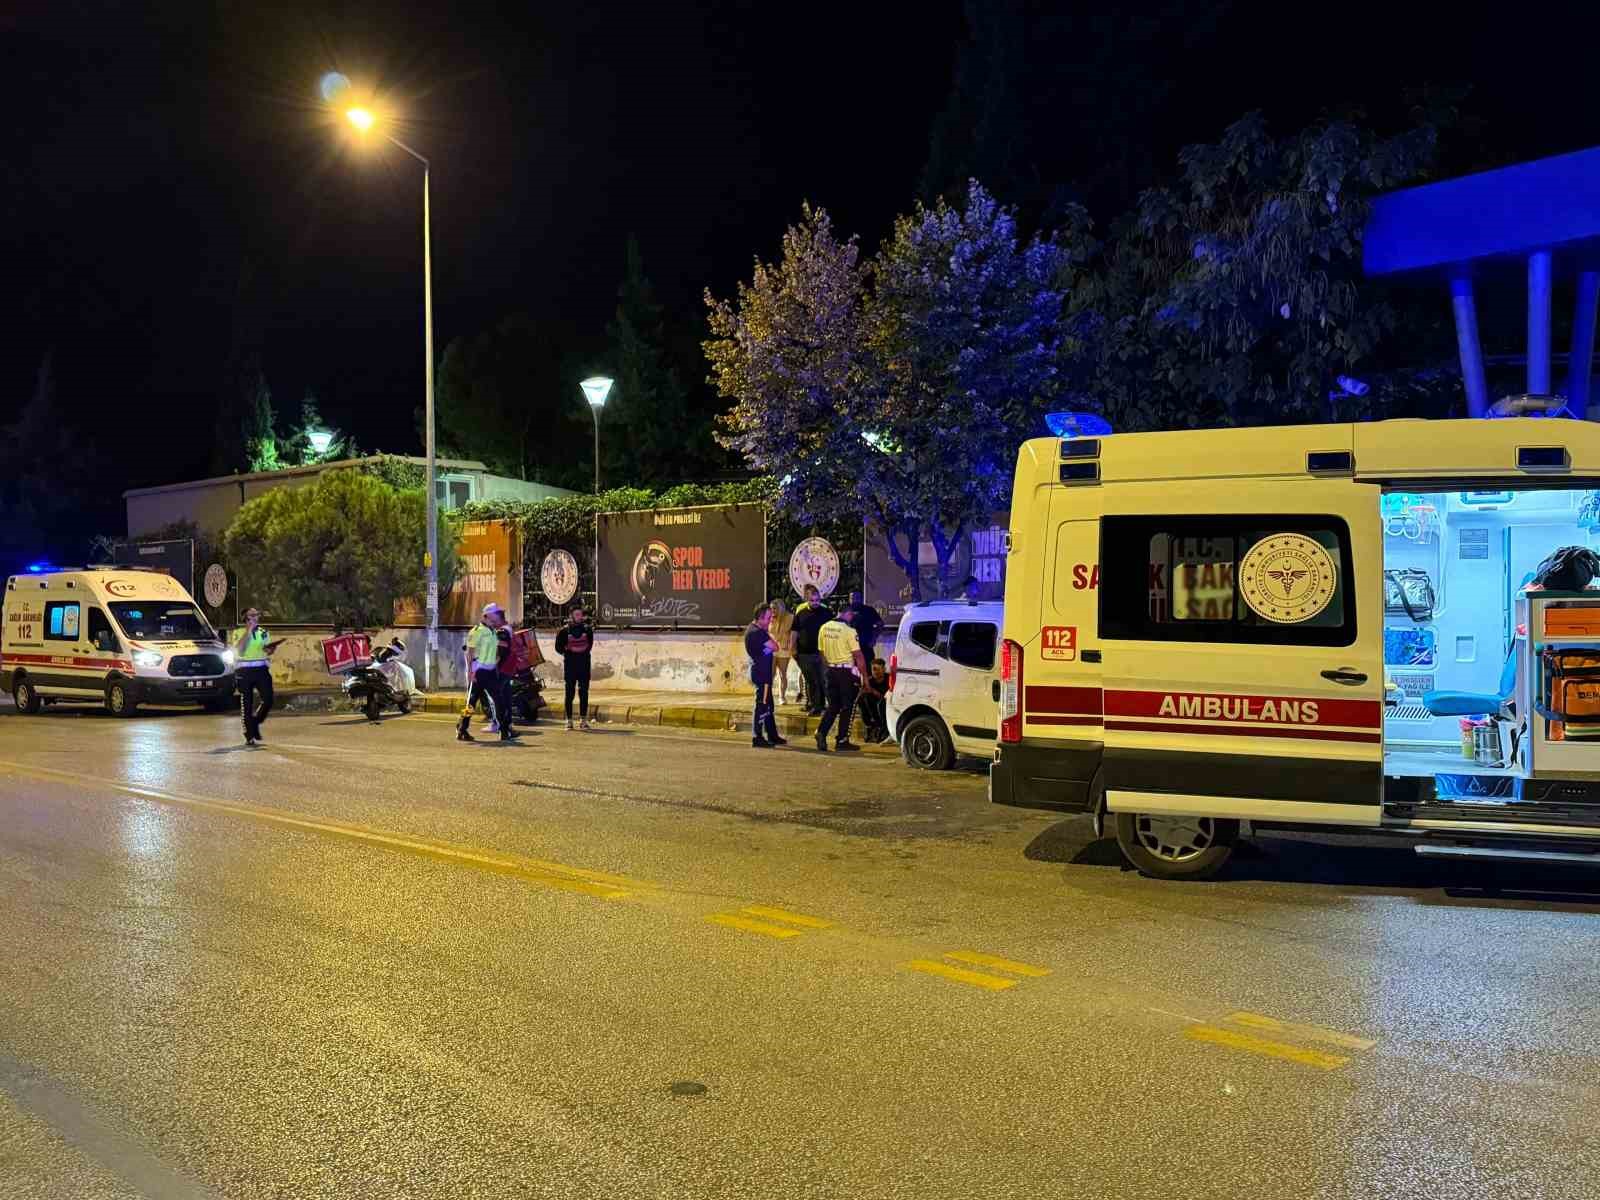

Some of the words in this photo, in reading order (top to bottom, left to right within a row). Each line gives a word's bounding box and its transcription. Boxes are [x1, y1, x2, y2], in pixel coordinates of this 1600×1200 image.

[973, 526, 1007, 554] MÜZ
[464, 550, 496, 573] OLOJİ
[672, 546, 704, 567] SPOR
[112, 584, 137, 592] 112
[469, 574, 496, 592] YERDE
[672, 569, 693, 591] HER
[696, 568, 731, 590] YERDE
[18, 624, 32, 639] 112
[1046, 630, 1072, 646] 112
[333, 643, 343, 661] Y
[1158, 695, 1320, 723] AMBULANS
